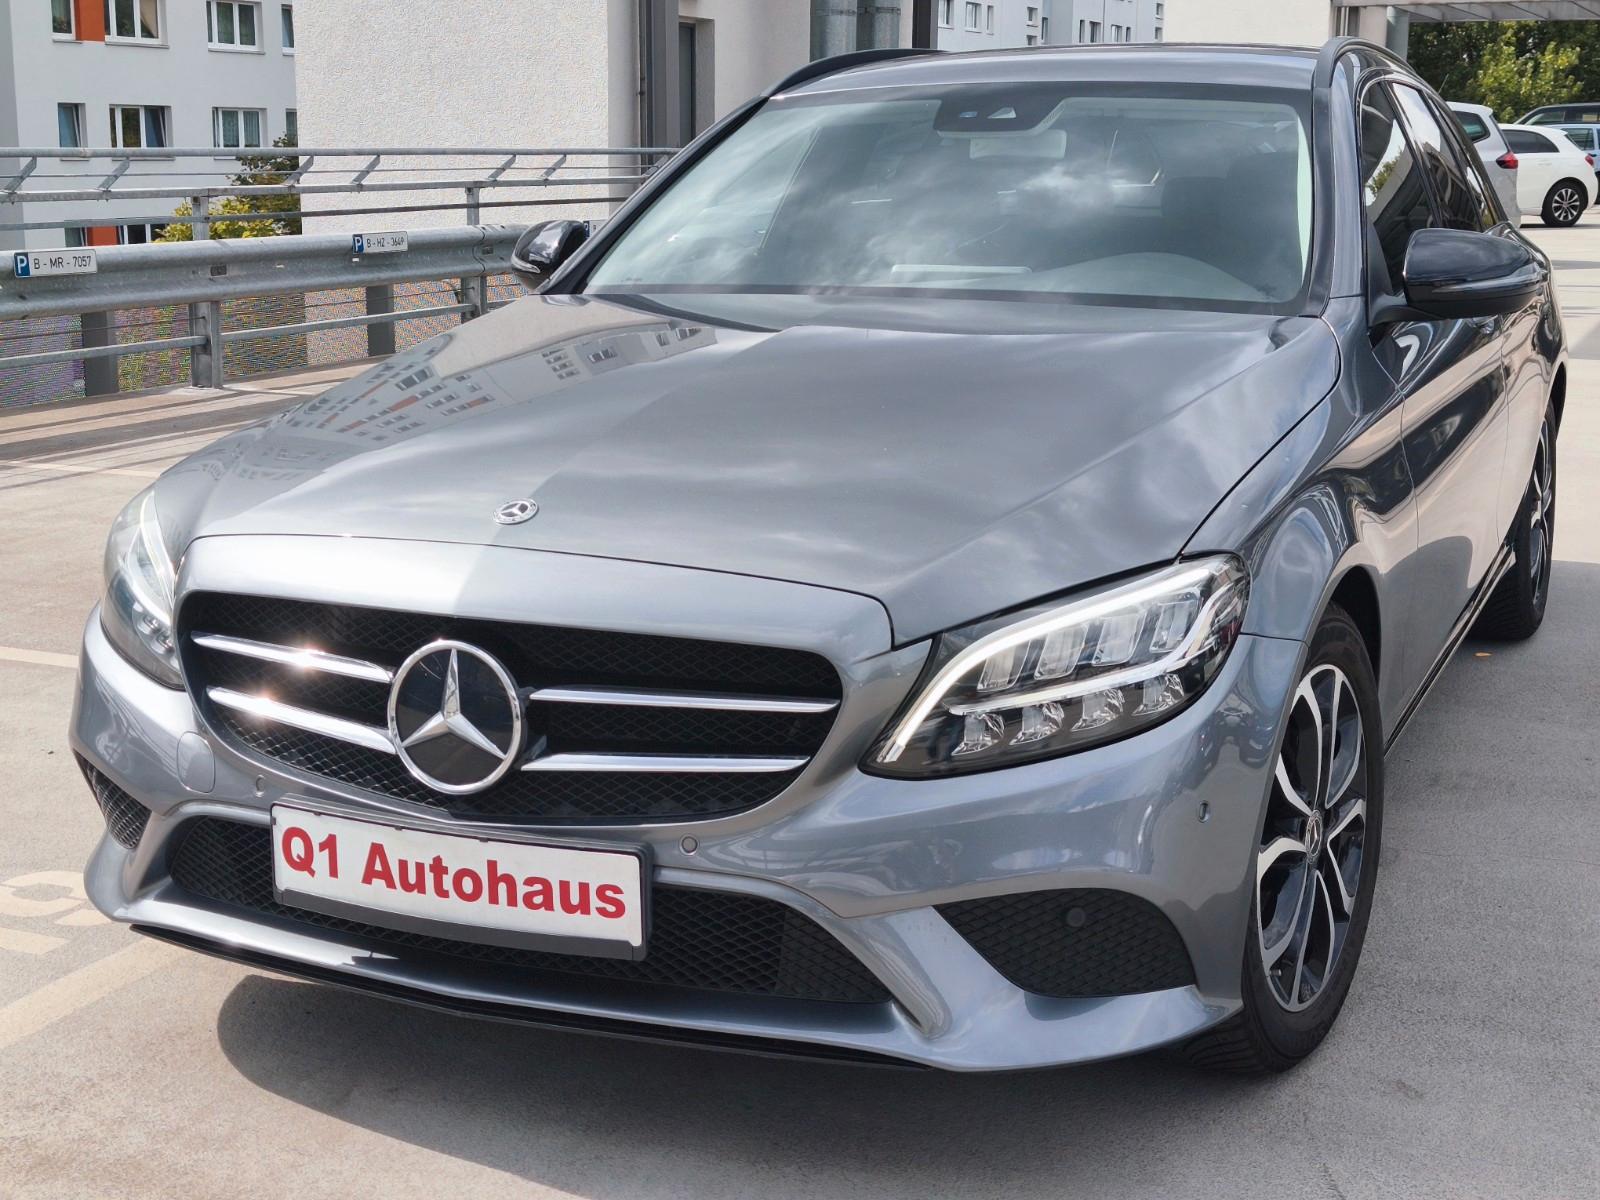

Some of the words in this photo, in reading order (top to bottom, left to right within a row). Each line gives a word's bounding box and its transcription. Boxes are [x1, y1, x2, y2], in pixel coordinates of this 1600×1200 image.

[355, 236, 362, 252] P
[16, 255, 27, 274] P
[33, 258, 40, 270] B
[50, 256, 64, 269] MR
[72, 255, 92, 267] 7057
[281, 826, 339, 879] Q1
[361, 842, 626, 919] Autohaus
